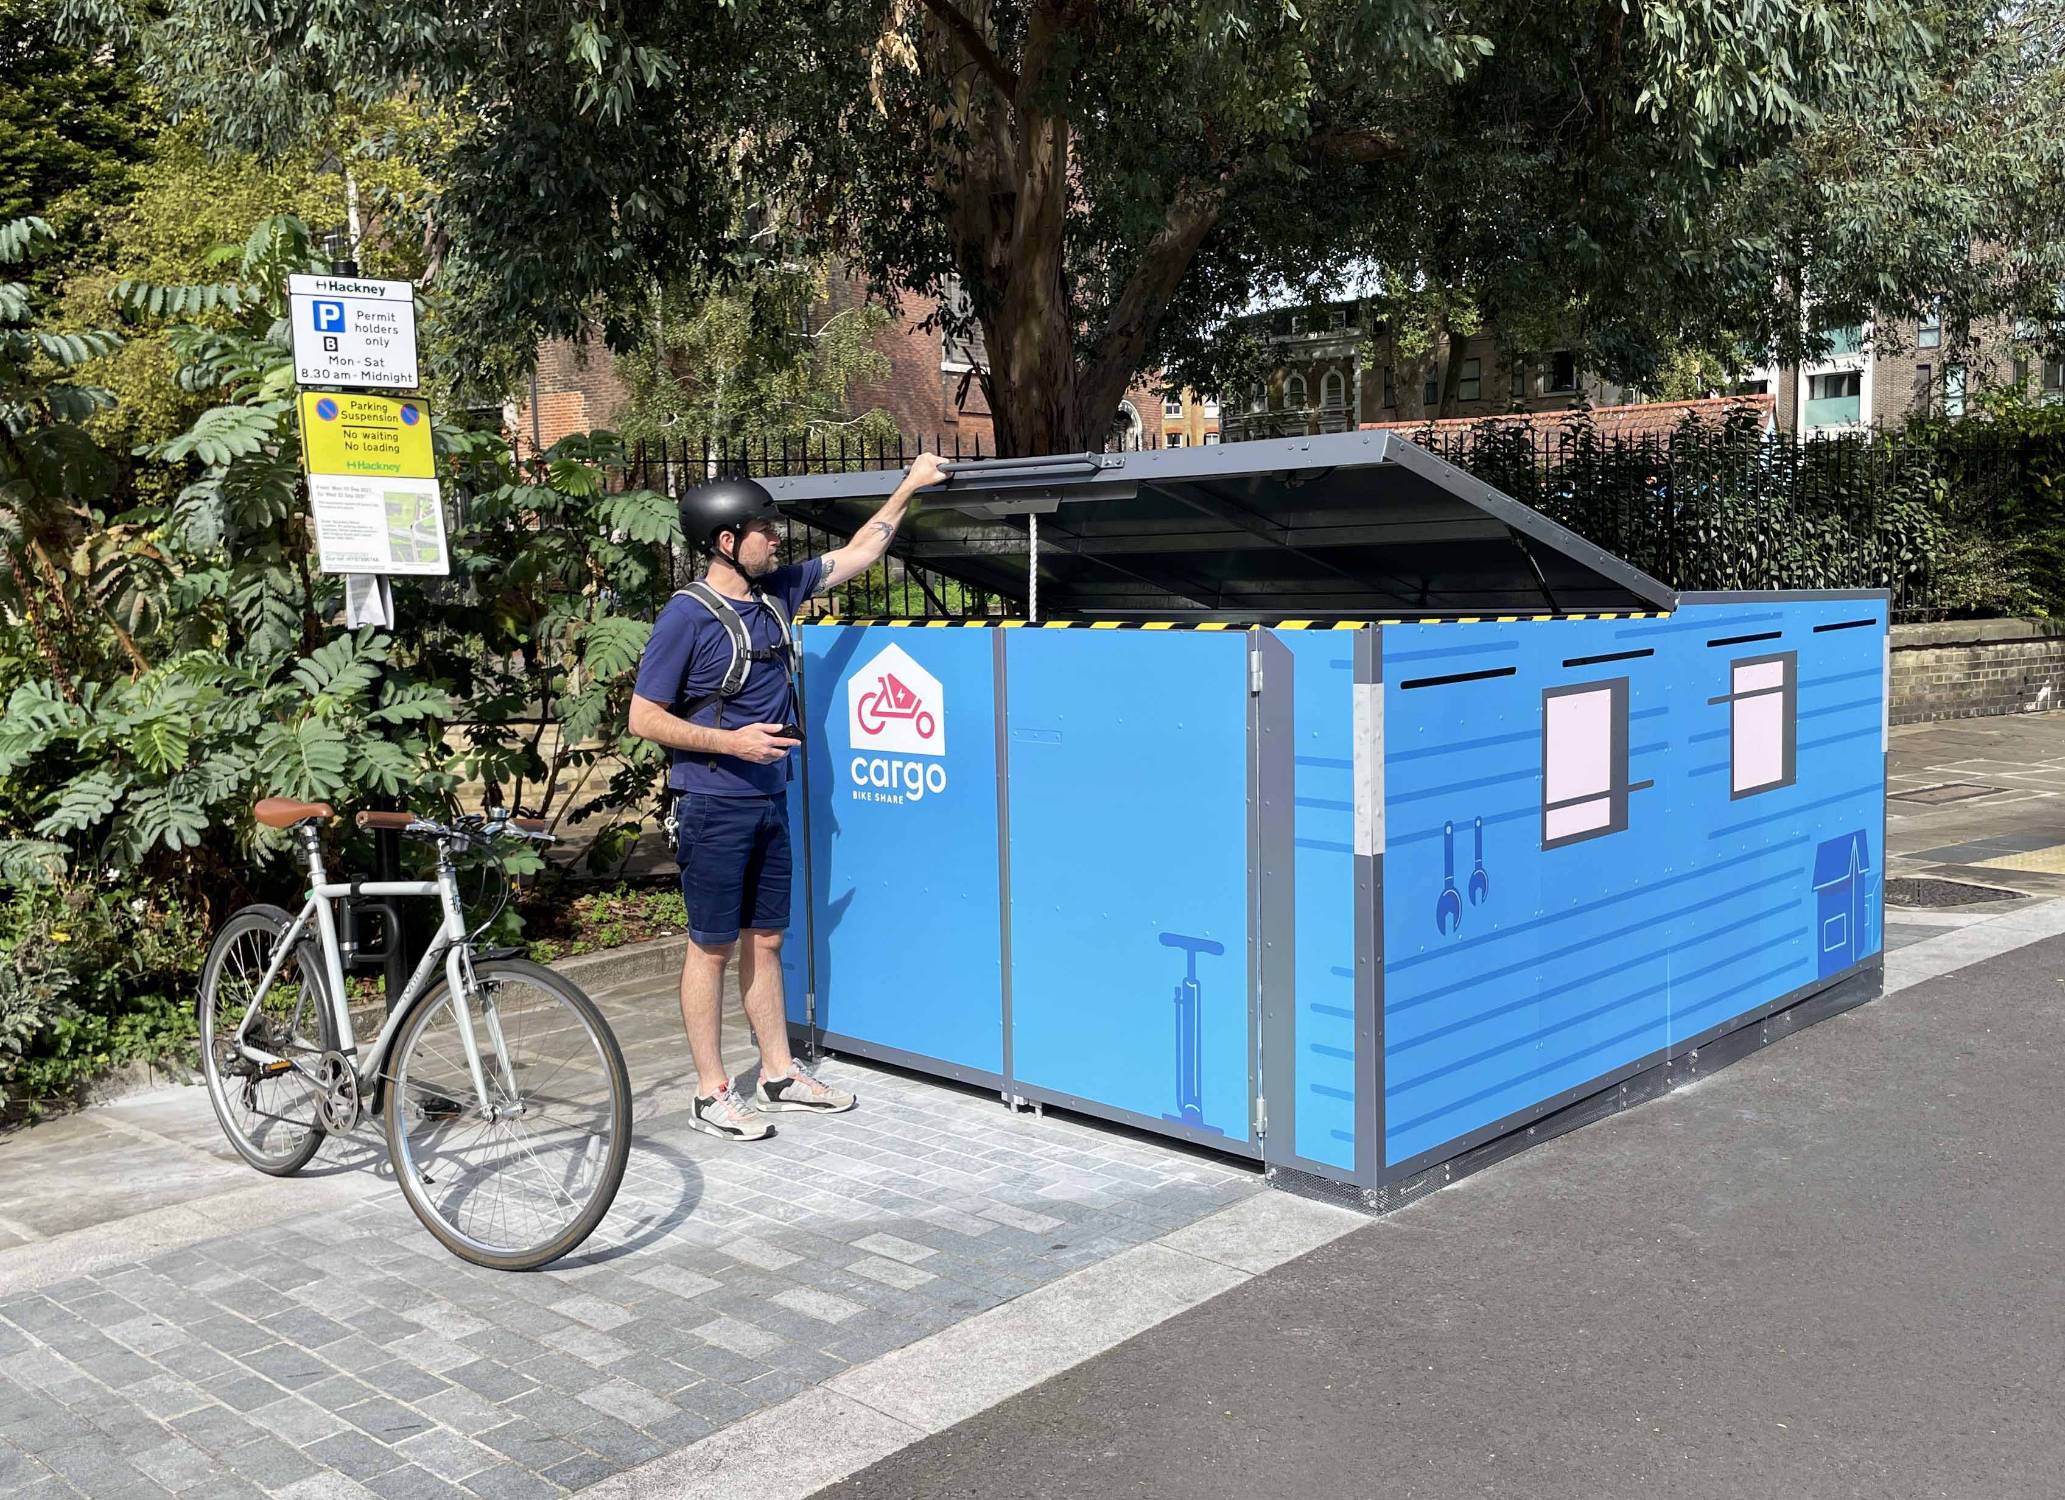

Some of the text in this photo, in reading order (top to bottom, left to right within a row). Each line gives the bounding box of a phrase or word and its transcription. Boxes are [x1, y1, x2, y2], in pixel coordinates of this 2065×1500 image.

[329, 280, 386, 297] Hackney
[318, 303, 340, 330] P
[356, 310, 397, 322] Permit
[354, 323, 399, 335] holders
[326, 338, 336, 349] B
[365, 337, 390, 348] only
[328, 355, 354, 366] Mon
[364, 357, 385, 367] Sat
[301, 368, 330, 379] 8.30
[333, 371, 351, 380] am
[361, 371, 413, 384] Midnight
[350, 400, 388, 414] Parking
[341, 411, 399, 423] Suspension
[343, 430, 399, 442] No waiting
[344, 442, 400, 454] No loading
[357, 460, 401, 472] Hackney
[851, 756, 947, 802] cargo
[852, 790, 904, 805] BIKE SHARE
